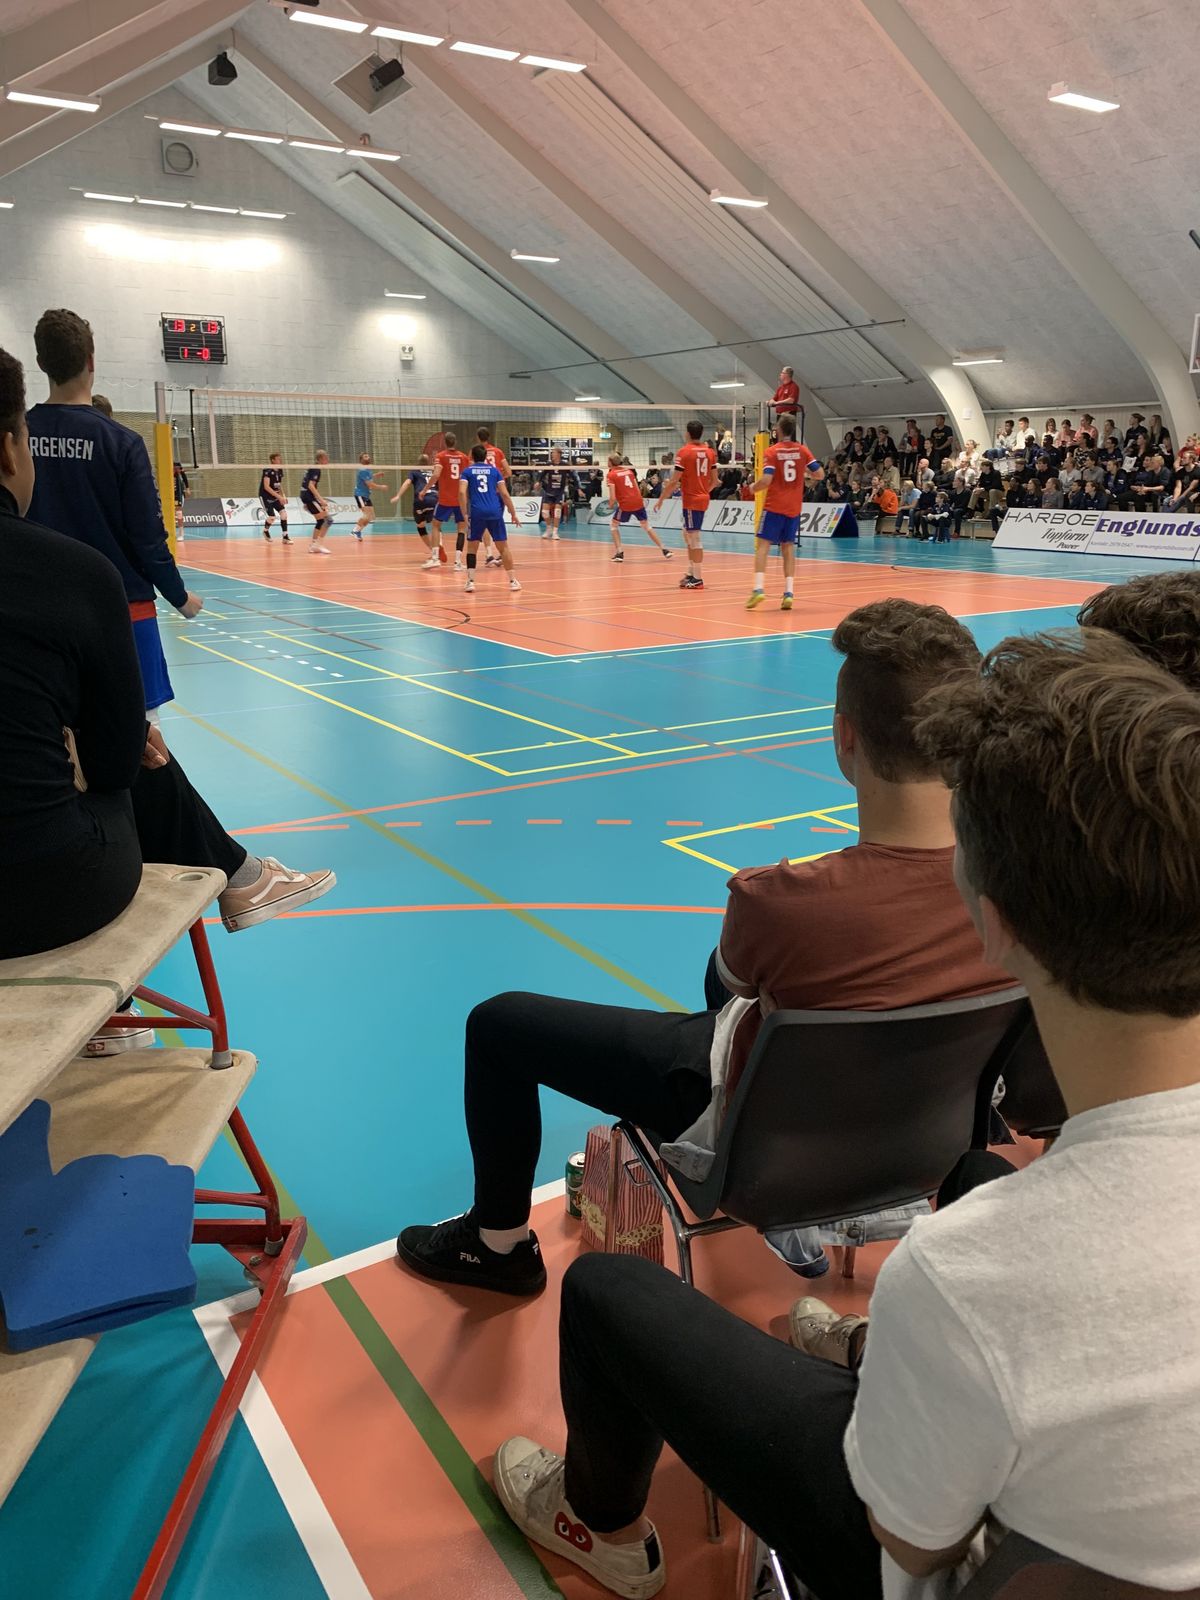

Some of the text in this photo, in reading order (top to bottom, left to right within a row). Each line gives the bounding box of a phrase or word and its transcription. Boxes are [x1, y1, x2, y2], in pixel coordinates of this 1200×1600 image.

[173, 319, 218, 334] 13 2 13
[29, 436, 94, 461] RGENSEN
[450, 463, 460, 480] 9
[696, 457, 708, 477] 14
[784, 460, 796, 482] 6
[476, 474, 489, 493] 3
[624, 475, 634, 488] 4
[329, 504, 357, 513] HOP.D
[800, 507, 827, 533] ek
[1004, 512, 1100, 526] HARBOE
[1041, 528, 1089, 543] Topform
[1056, 542, 1080, 550] Power
[460, 1252, 481, 1264] FILA
